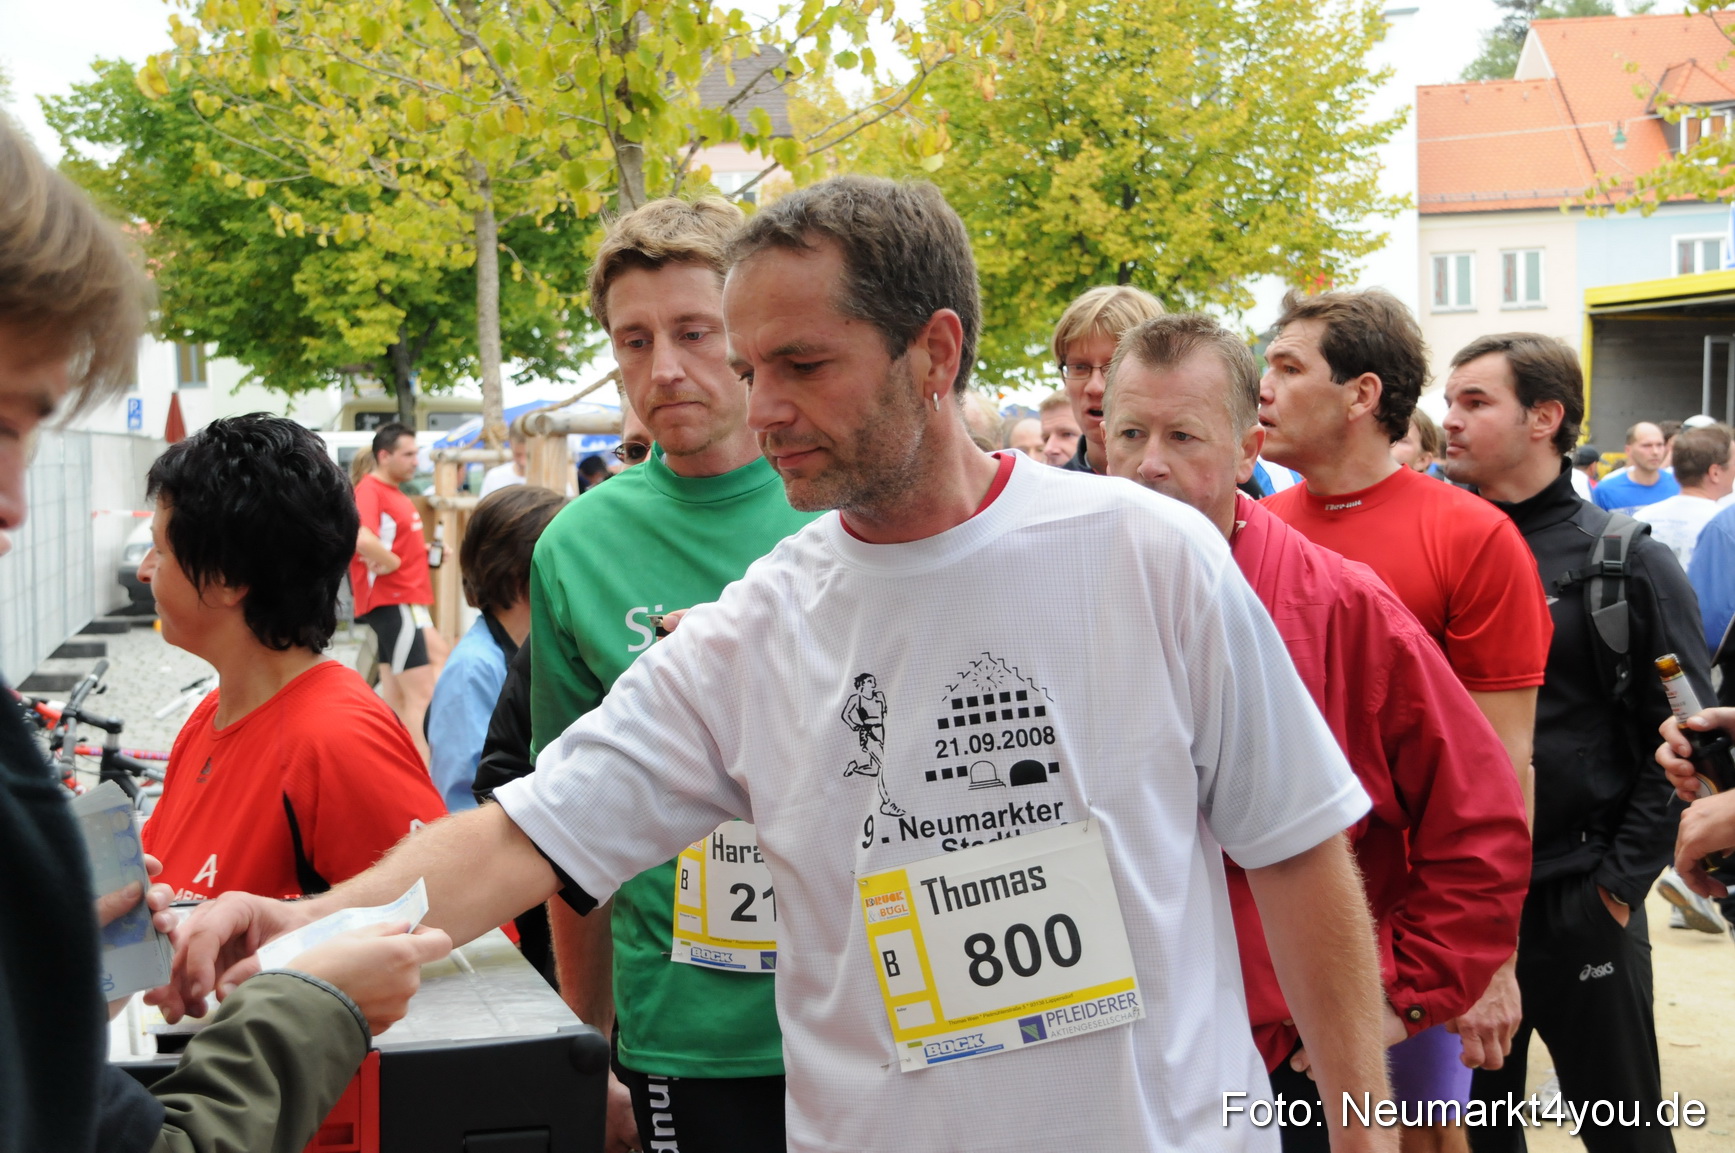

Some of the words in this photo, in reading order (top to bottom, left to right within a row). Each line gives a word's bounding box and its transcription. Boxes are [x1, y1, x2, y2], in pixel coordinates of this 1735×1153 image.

[625, 604, 663, 652] S
[935, 725, 1056, 759] 21.09.2008
[862, 814, 890, 849] 9.
[898, 800, 1064, 841] Neumarkter
[681, 868, 689, 890] B
[920, 865, 1047, 915] Thomas
[691, 947, 733, 963] BOCK
[882, 949, 901, 978] B
[963, 913, 1083, 987] 800
[1046, 992, 1138, 1027] PFLEIDERER
[924, 1033, 985, 1057] BOCK
